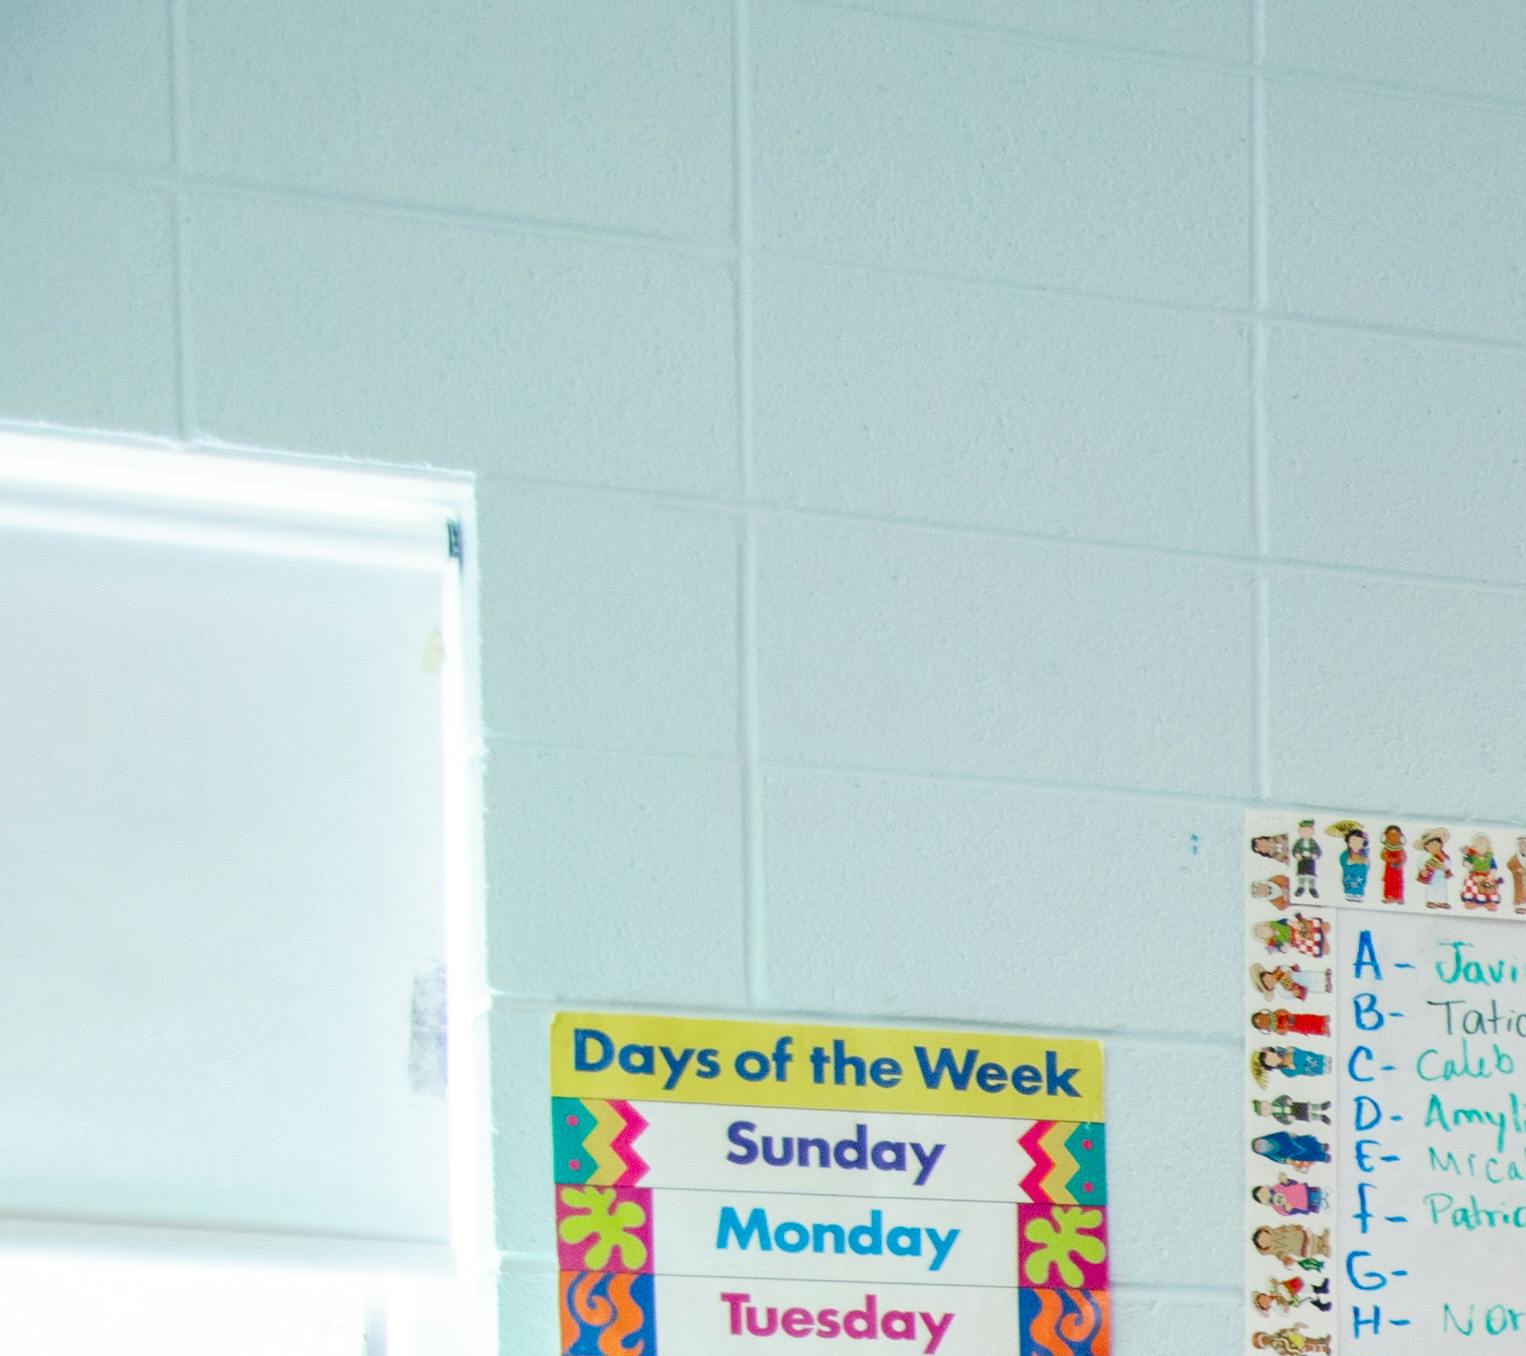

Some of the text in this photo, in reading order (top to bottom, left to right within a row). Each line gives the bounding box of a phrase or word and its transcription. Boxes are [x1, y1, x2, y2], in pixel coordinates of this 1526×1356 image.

[573, 1028, 1080, 1097] Days of the Week
[1416, 1037, 1514, 1081] Caleb
[727, 1121, 945, 1186] Sunday
[716, 1206, 960, 1271] Monday
[721, 1293, 954, 1355] Tuesday
